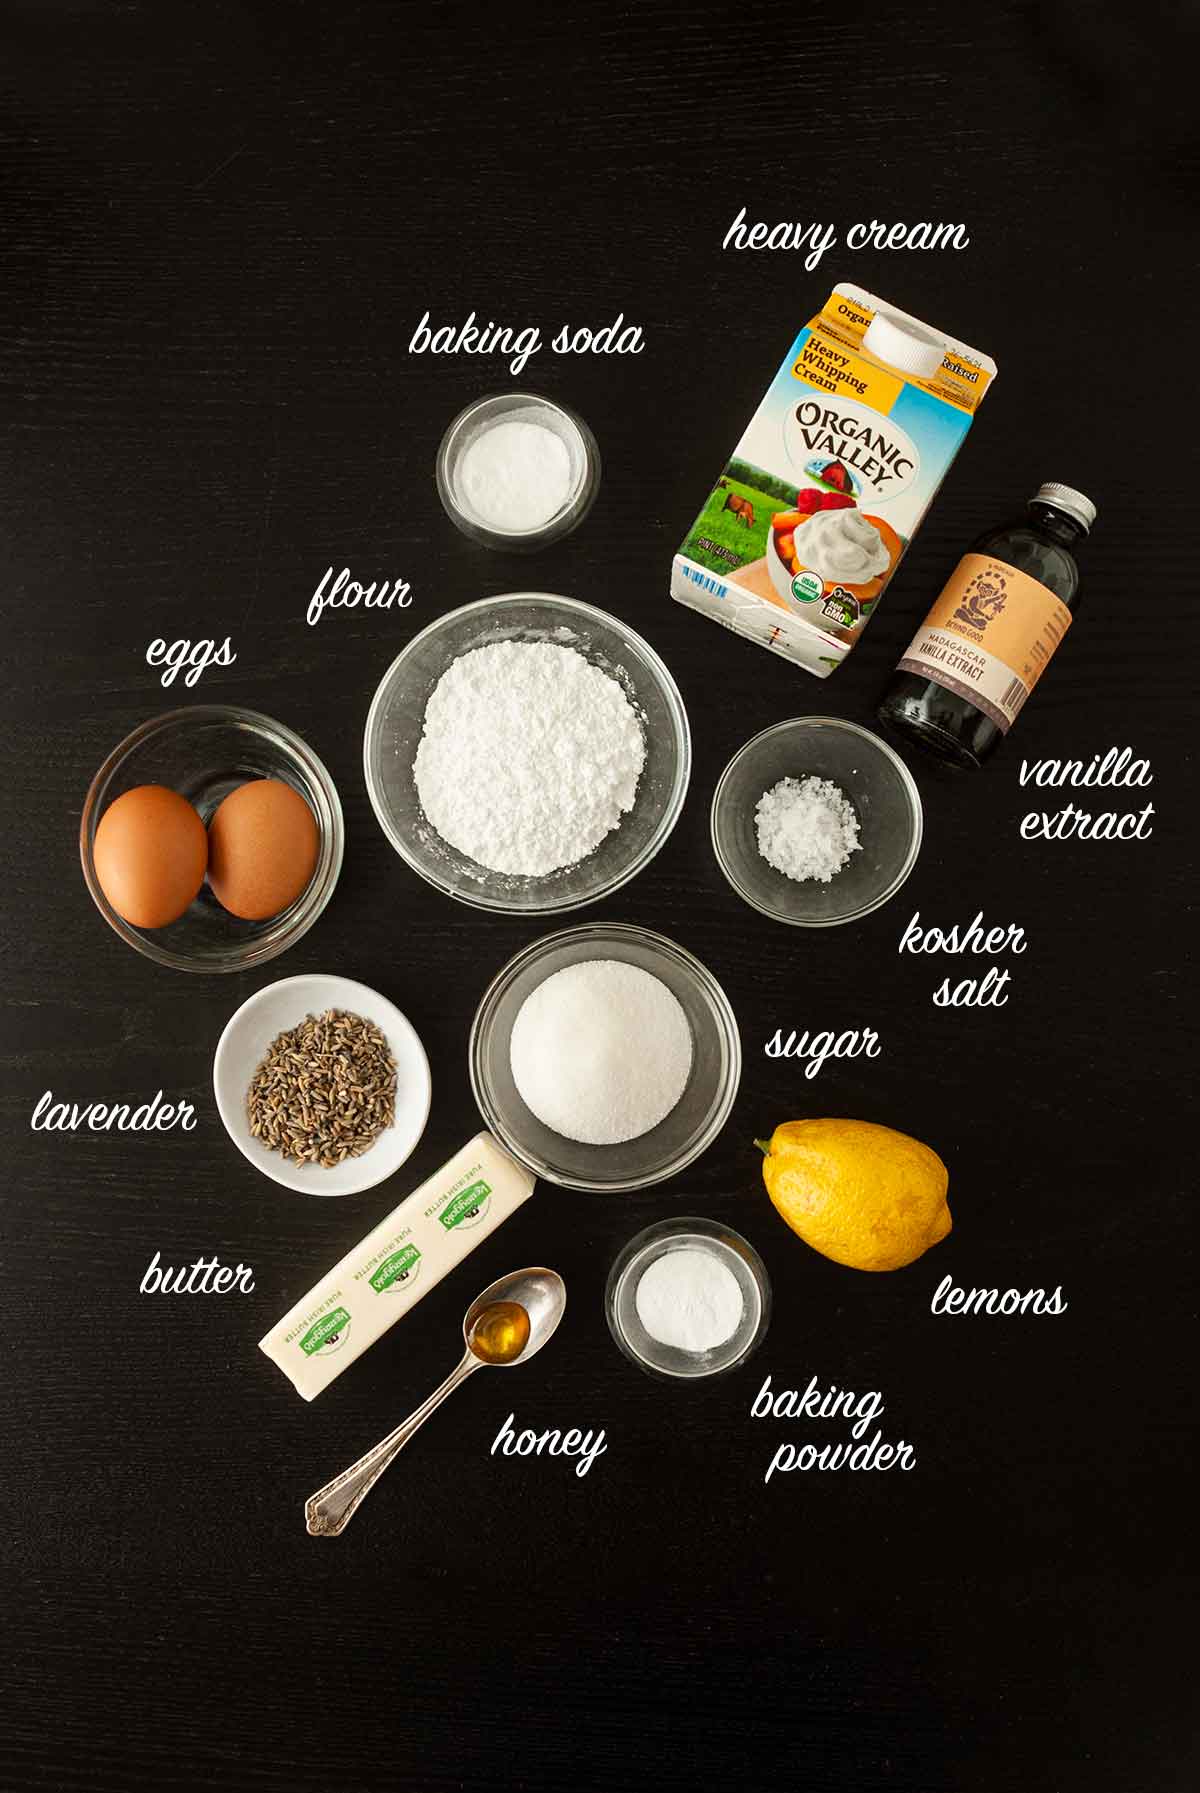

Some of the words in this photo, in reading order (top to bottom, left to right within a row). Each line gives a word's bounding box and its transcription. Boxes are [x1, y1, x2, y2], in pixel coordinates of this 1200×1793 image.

[838, 303, 873, 329] Organ
[807, 337, 851, 368] Heavy
[794, 361, 838, 393] Cream
[802, 349, 869, 395] Whipping
[942, 357, 979, 384] Raised
[795, 402, 915, 479] ORGANIC
[801, 428, 893, 487] VALLEY
[801, 576, 818, 590] USDA
[824, 606, 846, 624] GMO
[828, 600, 843, 613] non
[919, 642, 948, 664] VANILLA
[946, 653, 985, 682] EXTRACT
[928, 633, 987, 667] MADAGASCAR
